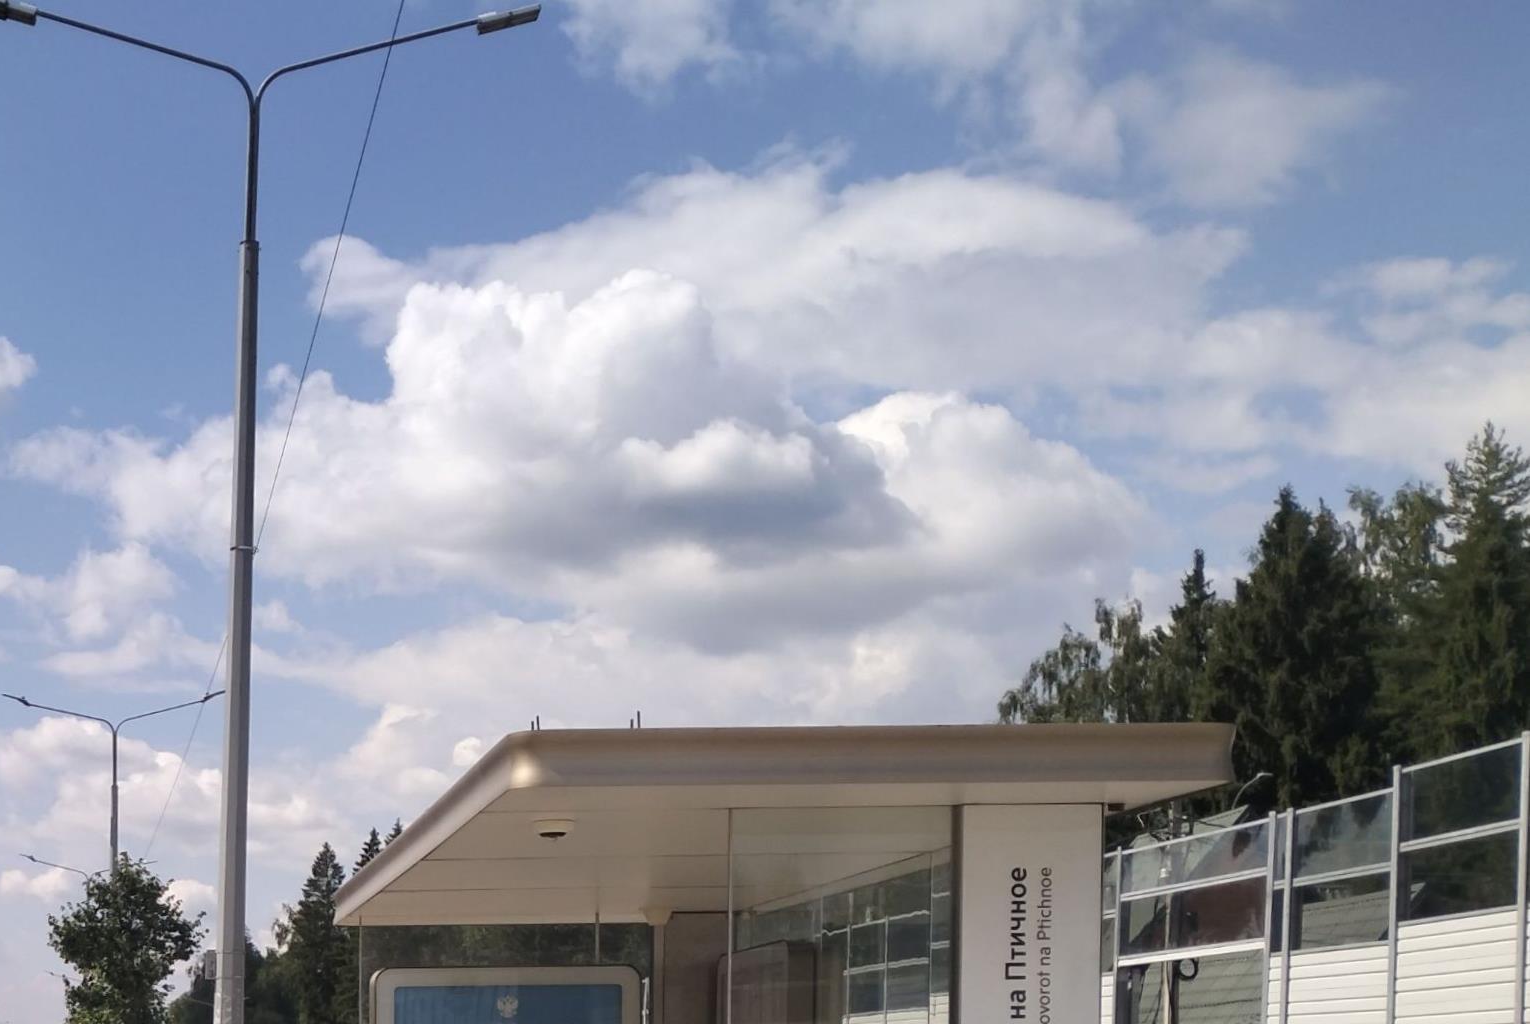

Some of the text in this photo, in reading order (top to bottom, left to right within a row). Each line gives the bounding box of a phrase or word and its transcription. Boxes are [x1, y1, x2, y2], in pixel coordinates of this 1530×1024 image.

[1005, 867, 1028, 980] Птичное
[1036, 867, 1053, 941] Ptichnoe
[1040, 946, 1052, 966] na
[1010, 989, 1027, 1020] на
